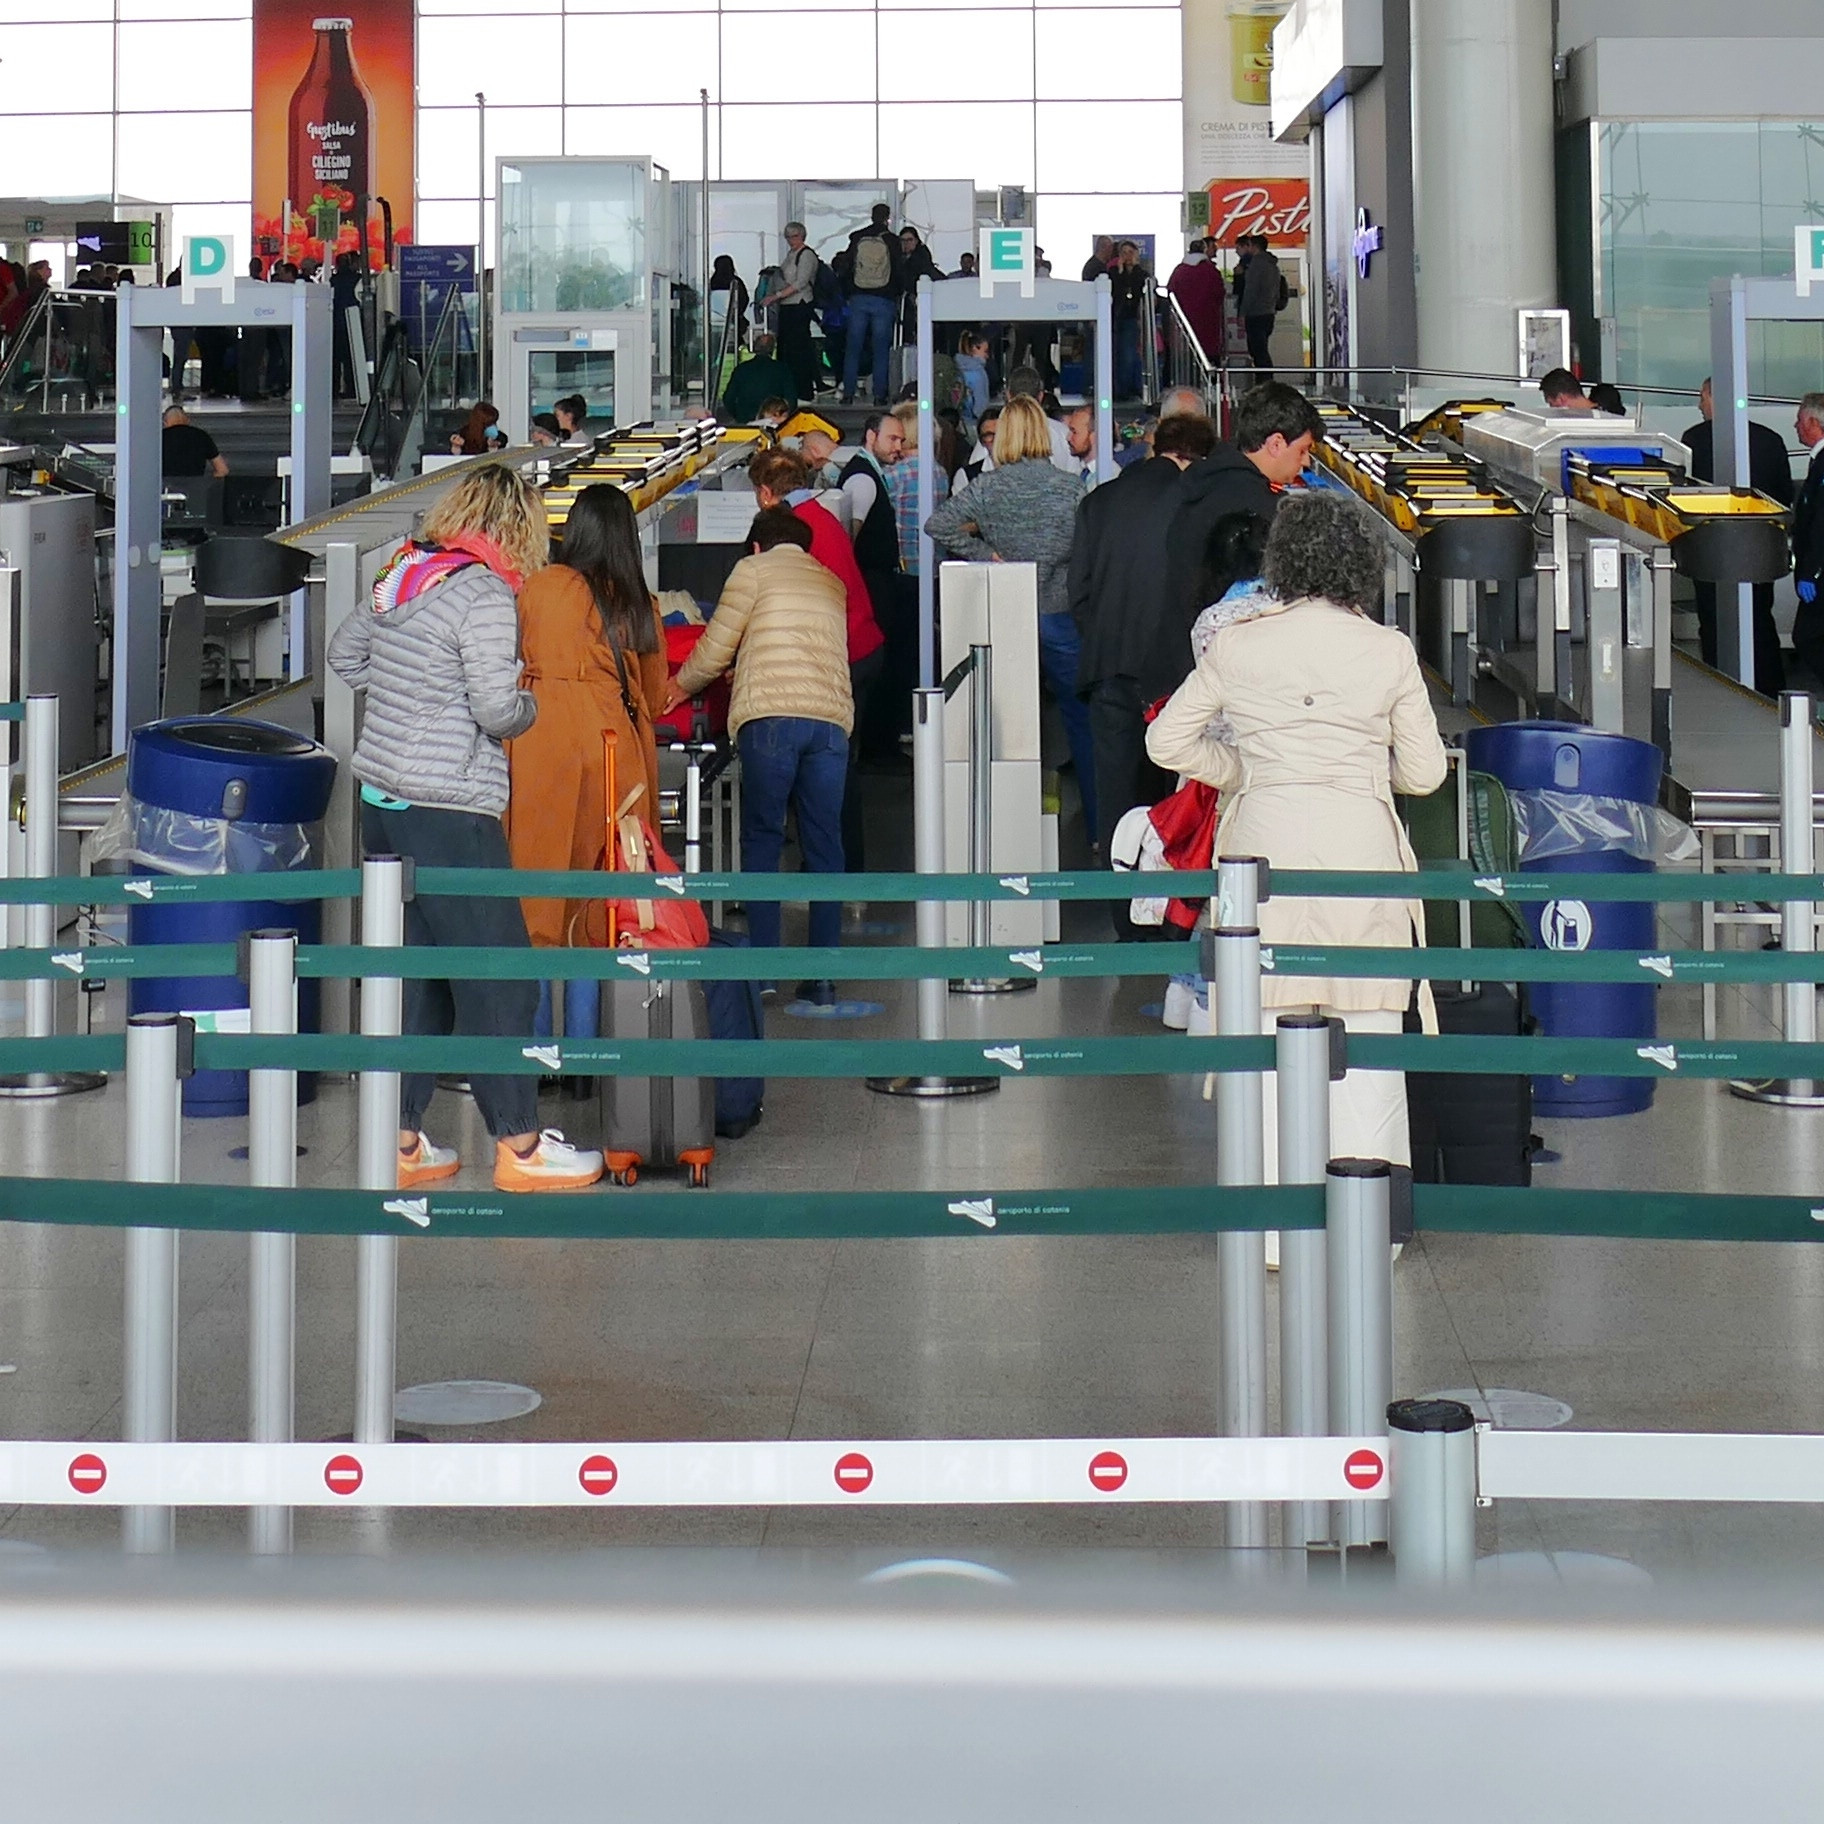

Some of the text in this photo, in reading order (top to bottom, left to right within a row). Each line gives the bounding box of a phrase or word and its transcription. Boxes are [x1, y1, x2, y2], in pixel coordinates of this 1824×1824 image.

[1201, 121, 1236, 132] CREMA
[1238, 121, 1248, 131] DI
[131, 232, 152, 248] 10
[990, 230, 1024, 271] E
[188, 238, 225, 275] D
